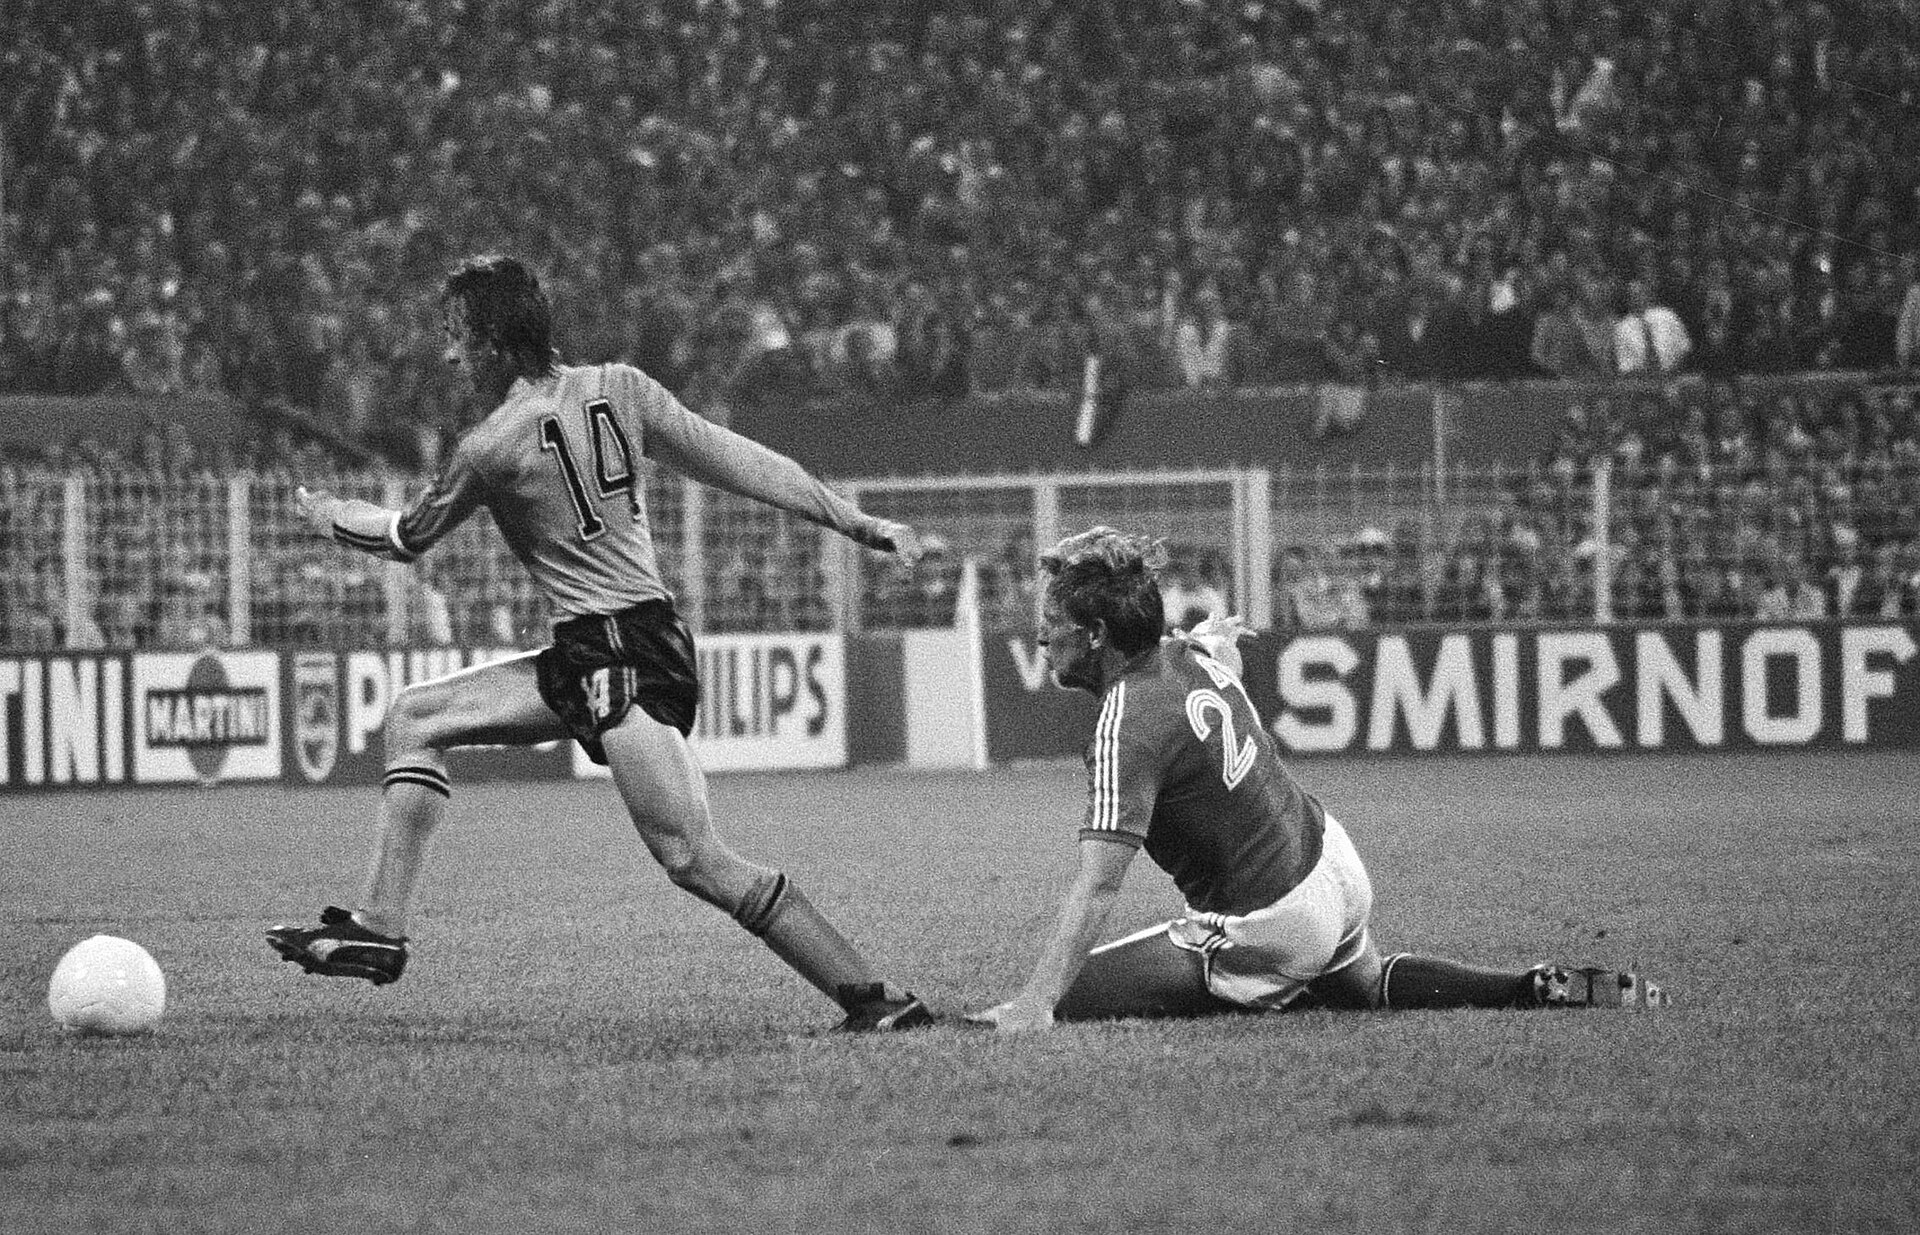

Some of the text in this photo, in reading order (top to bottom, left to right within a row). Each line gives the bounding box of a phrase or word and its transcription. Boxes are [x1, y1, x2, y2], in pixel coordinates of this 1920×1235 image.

[541, 398, 641, 541] 14
[149, 695, 268, 741] MARTINI
[1274, 627, 1917, 751] SMIRNOF
